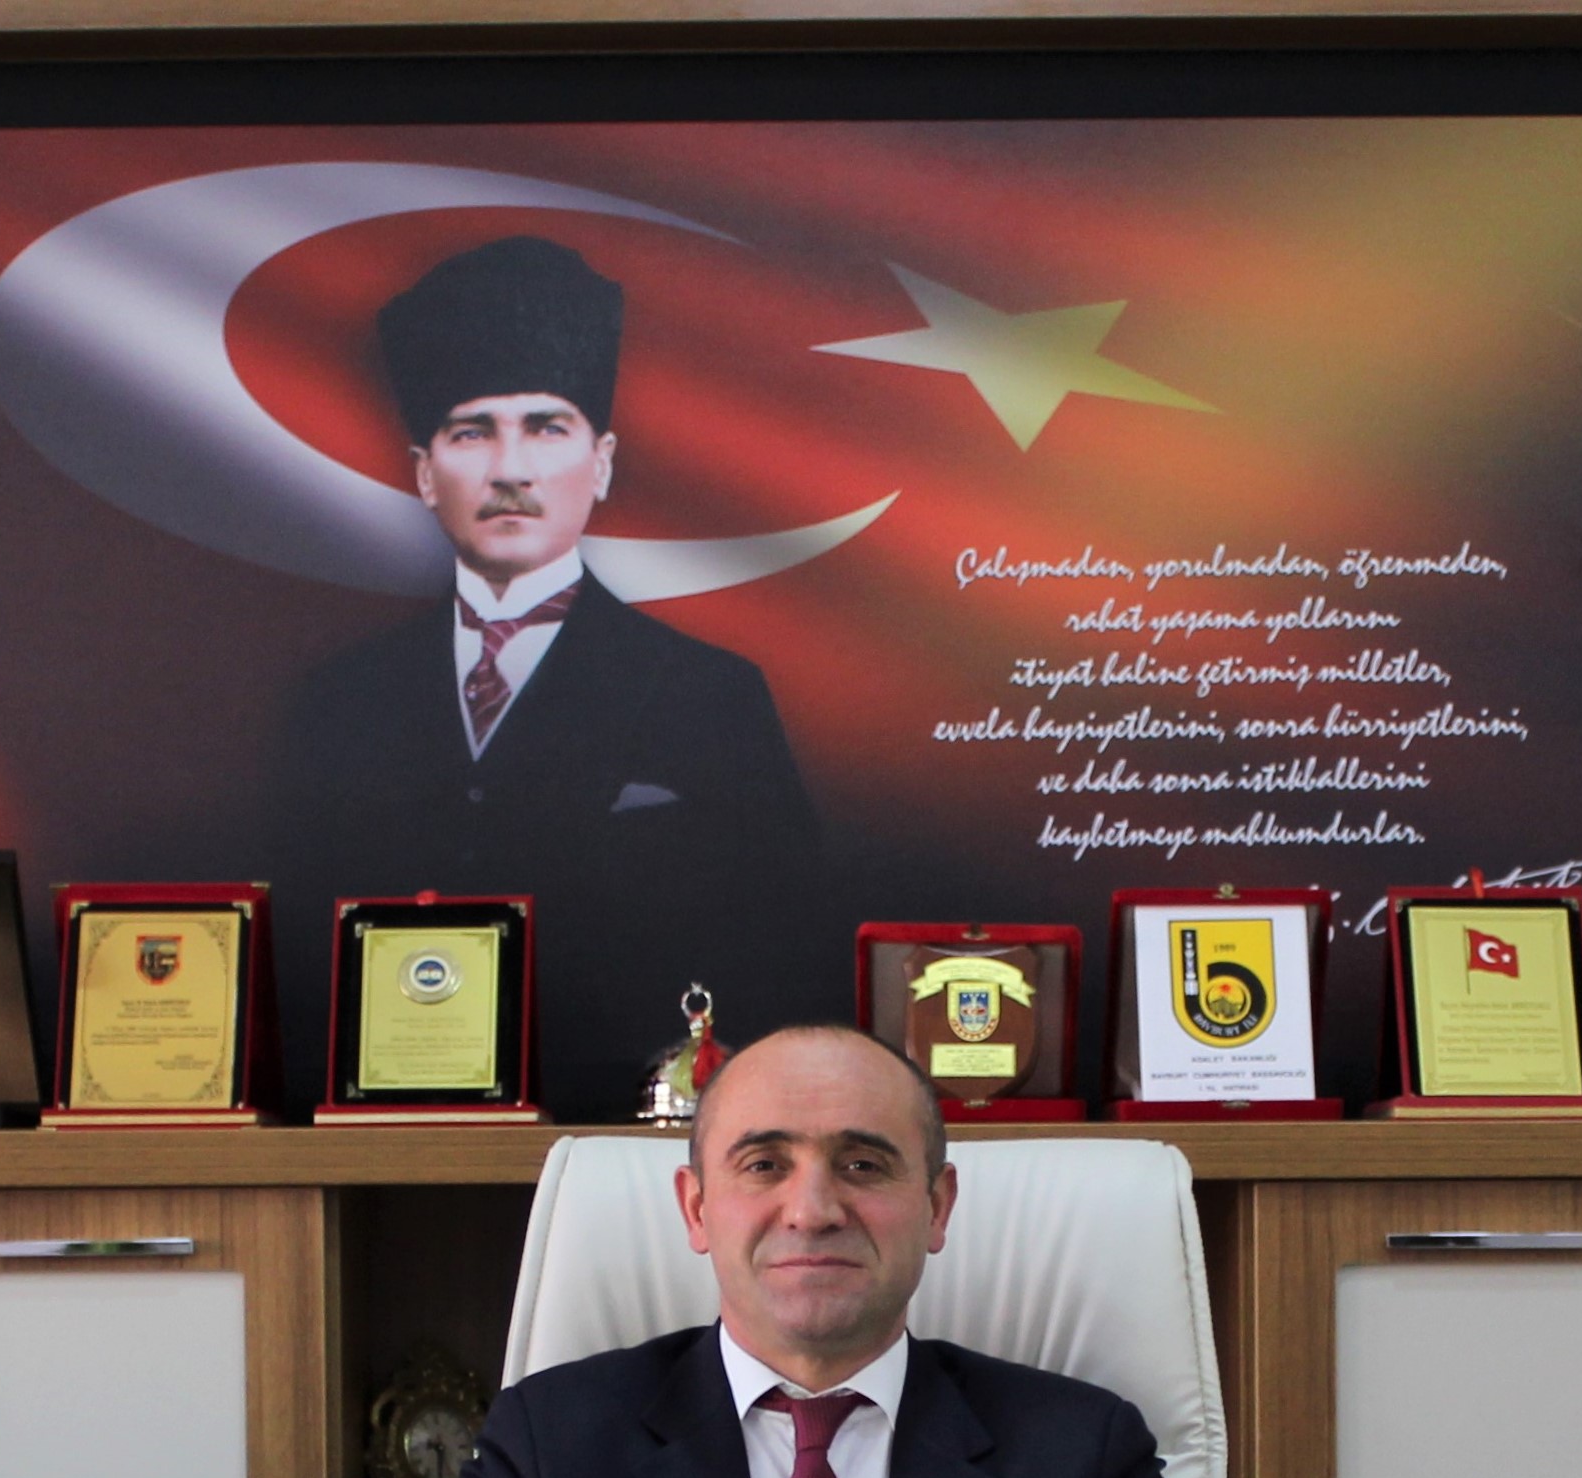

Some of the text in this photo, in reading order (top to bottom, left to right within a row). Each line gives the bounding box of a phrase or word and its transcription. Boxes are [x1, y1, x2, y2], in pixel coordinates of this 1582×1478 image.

[955, 545, 1136, 591] Çalışmadan,
[1142, 542, 1331, 591] yorulmadan,
[1064, 595, 1402, 646] rahat yaşama yollarını
[1009, 648, 1452, 701] itiyat haline getirmiş milletler,
[932, 702, 1530, 754] evvela haysiyetlerini, sonra hürriyetlerini,
[1036, 755, 1433, 795] ve daha sonra istikballerini
[1036, 811, 1427, 862] kaybetmeye mahkumdurlar.
